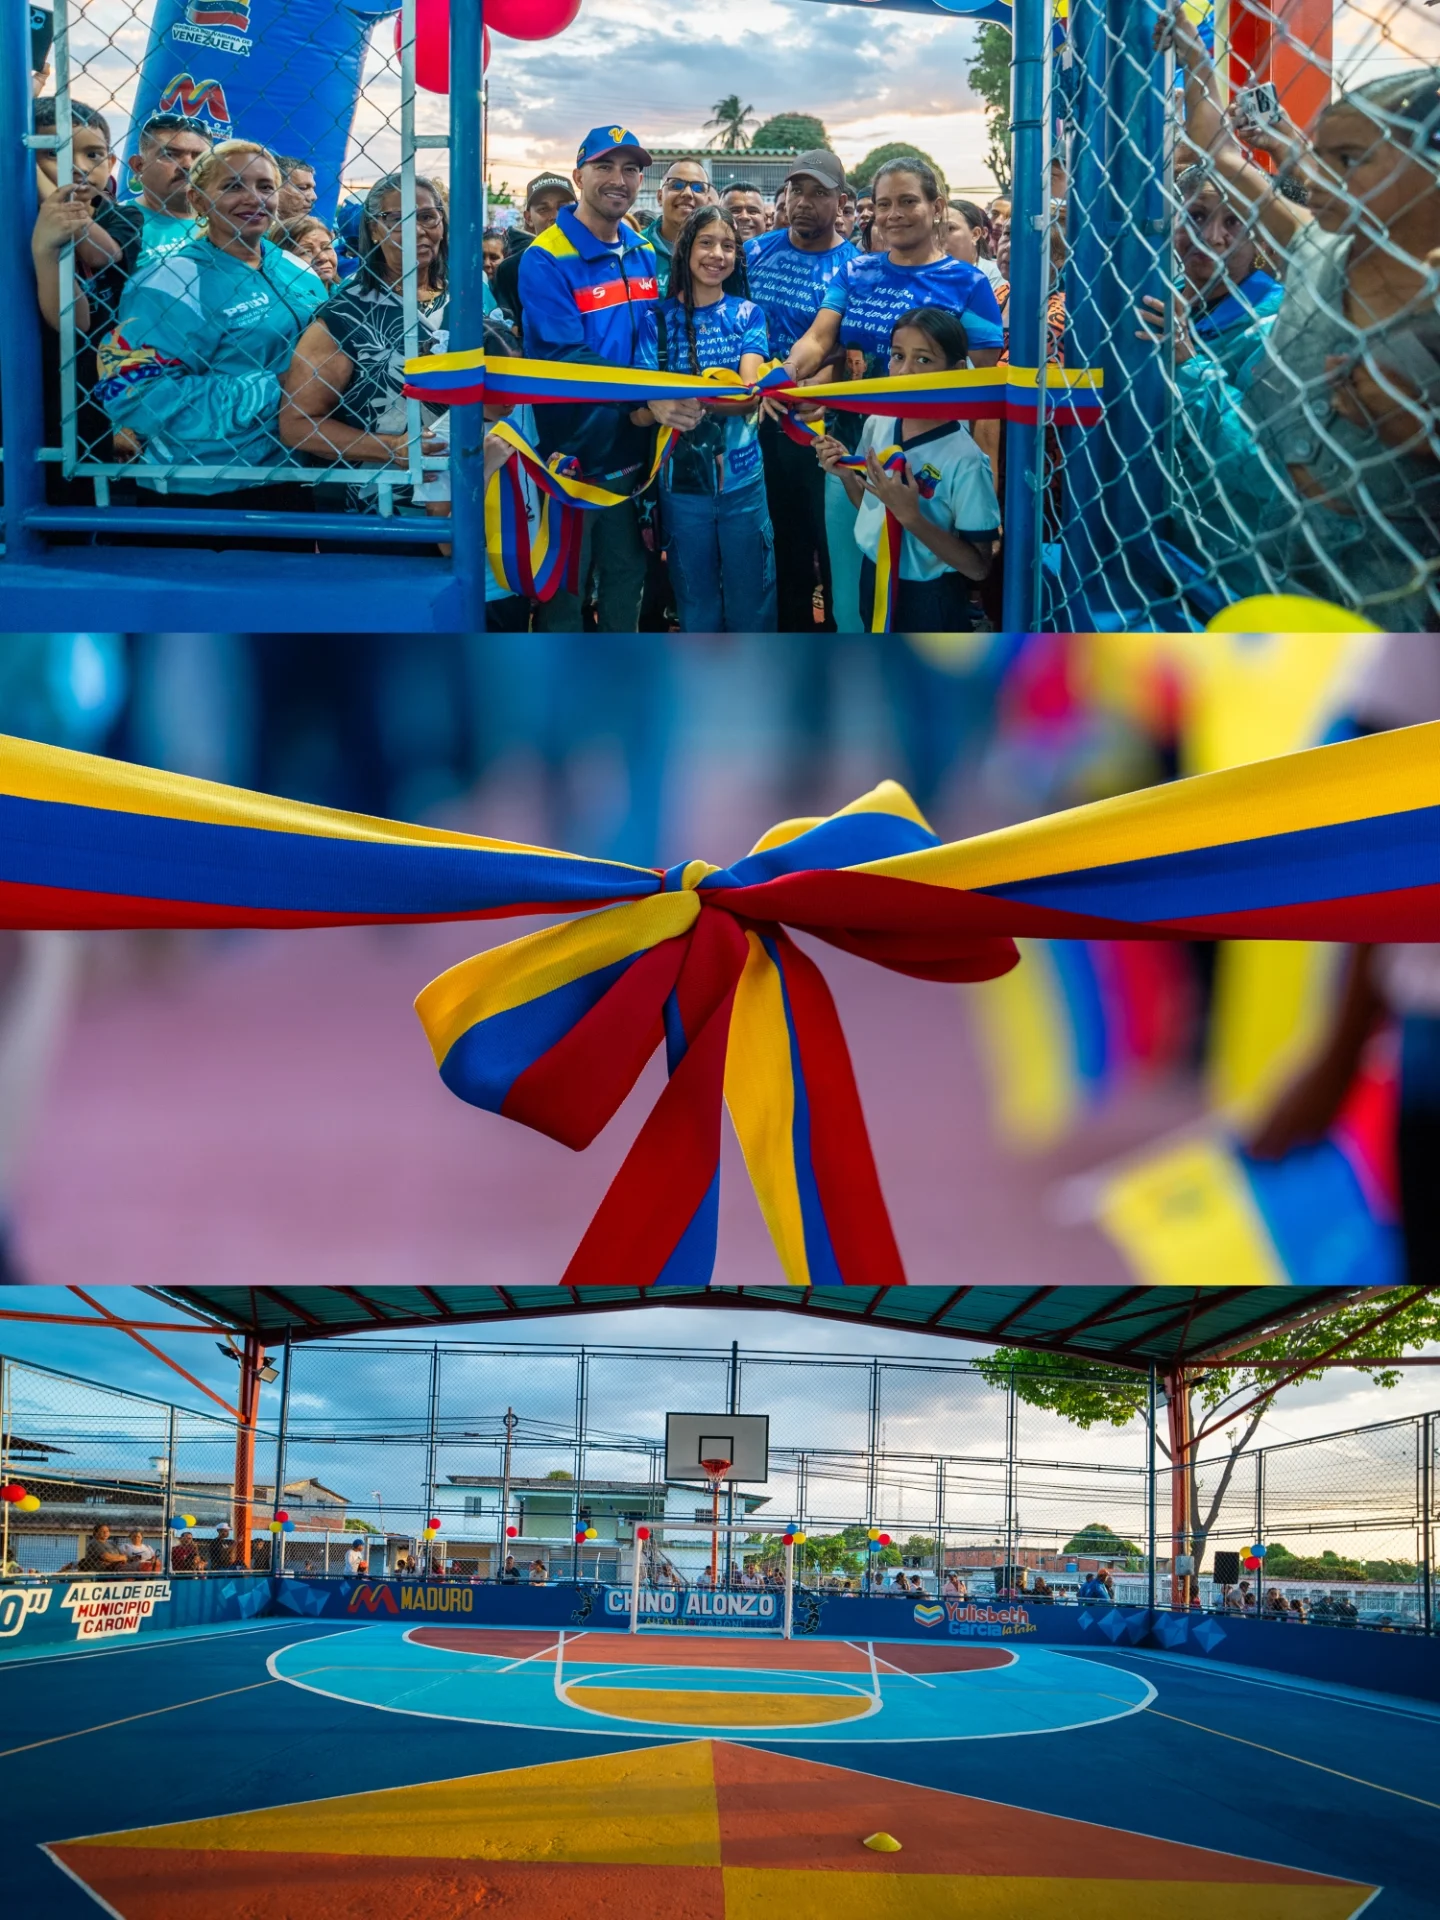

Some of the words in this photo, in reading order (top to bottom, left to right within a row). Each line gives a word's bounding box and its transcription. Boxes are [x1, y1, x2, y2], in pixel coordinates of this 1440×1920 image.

[173, 30, 249, 55] VENEZUELA
[69, 1585, 142, 1602] ALCALDE
[145, 1584, 169, 1598] DEL
[401, 1586, 473, 1612] MADURO
[608, 1591, 675, 1614] CHINO
[686, 1593, 774, 1616] ALONZO
[77, 1600, 151, 1618] MUNICIPIO
[945, 1602, 1029, 1624] Yulisbeth
[83, 1613, 139, 1634] CARONÍ
[1002, 1625, 1013, 1636] la
